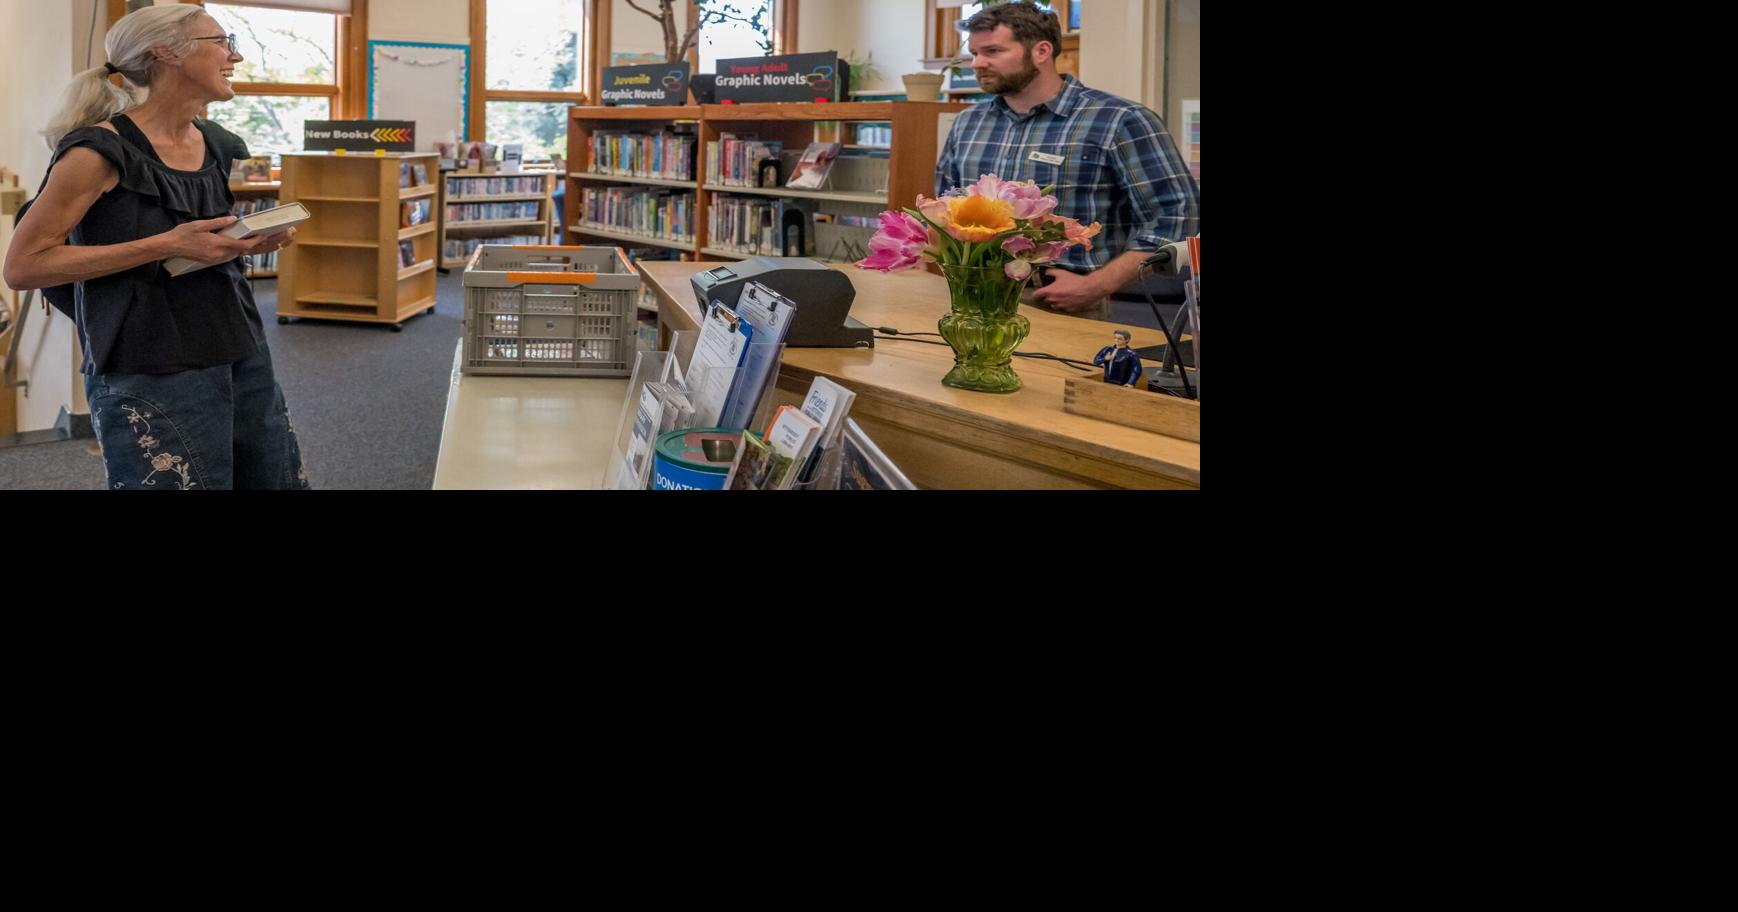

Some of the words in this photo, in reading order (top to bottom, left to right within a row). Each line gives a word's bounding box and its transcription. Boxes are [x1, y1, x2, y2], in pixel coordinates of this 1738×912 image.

[729, 65, 760, 75] Young
[761, 62, 788, 73] Adult
[614, 74, 650, 85] Juvenile
[715, 73, 761, 88] Graphic
[763, 72, 807, 86] Novels
[601, 88, 633, 102] Graphic
[634, 87, 665, 99] Novels
[305, 130, 331, 139] New
[333, 130, 369, 139] Books
